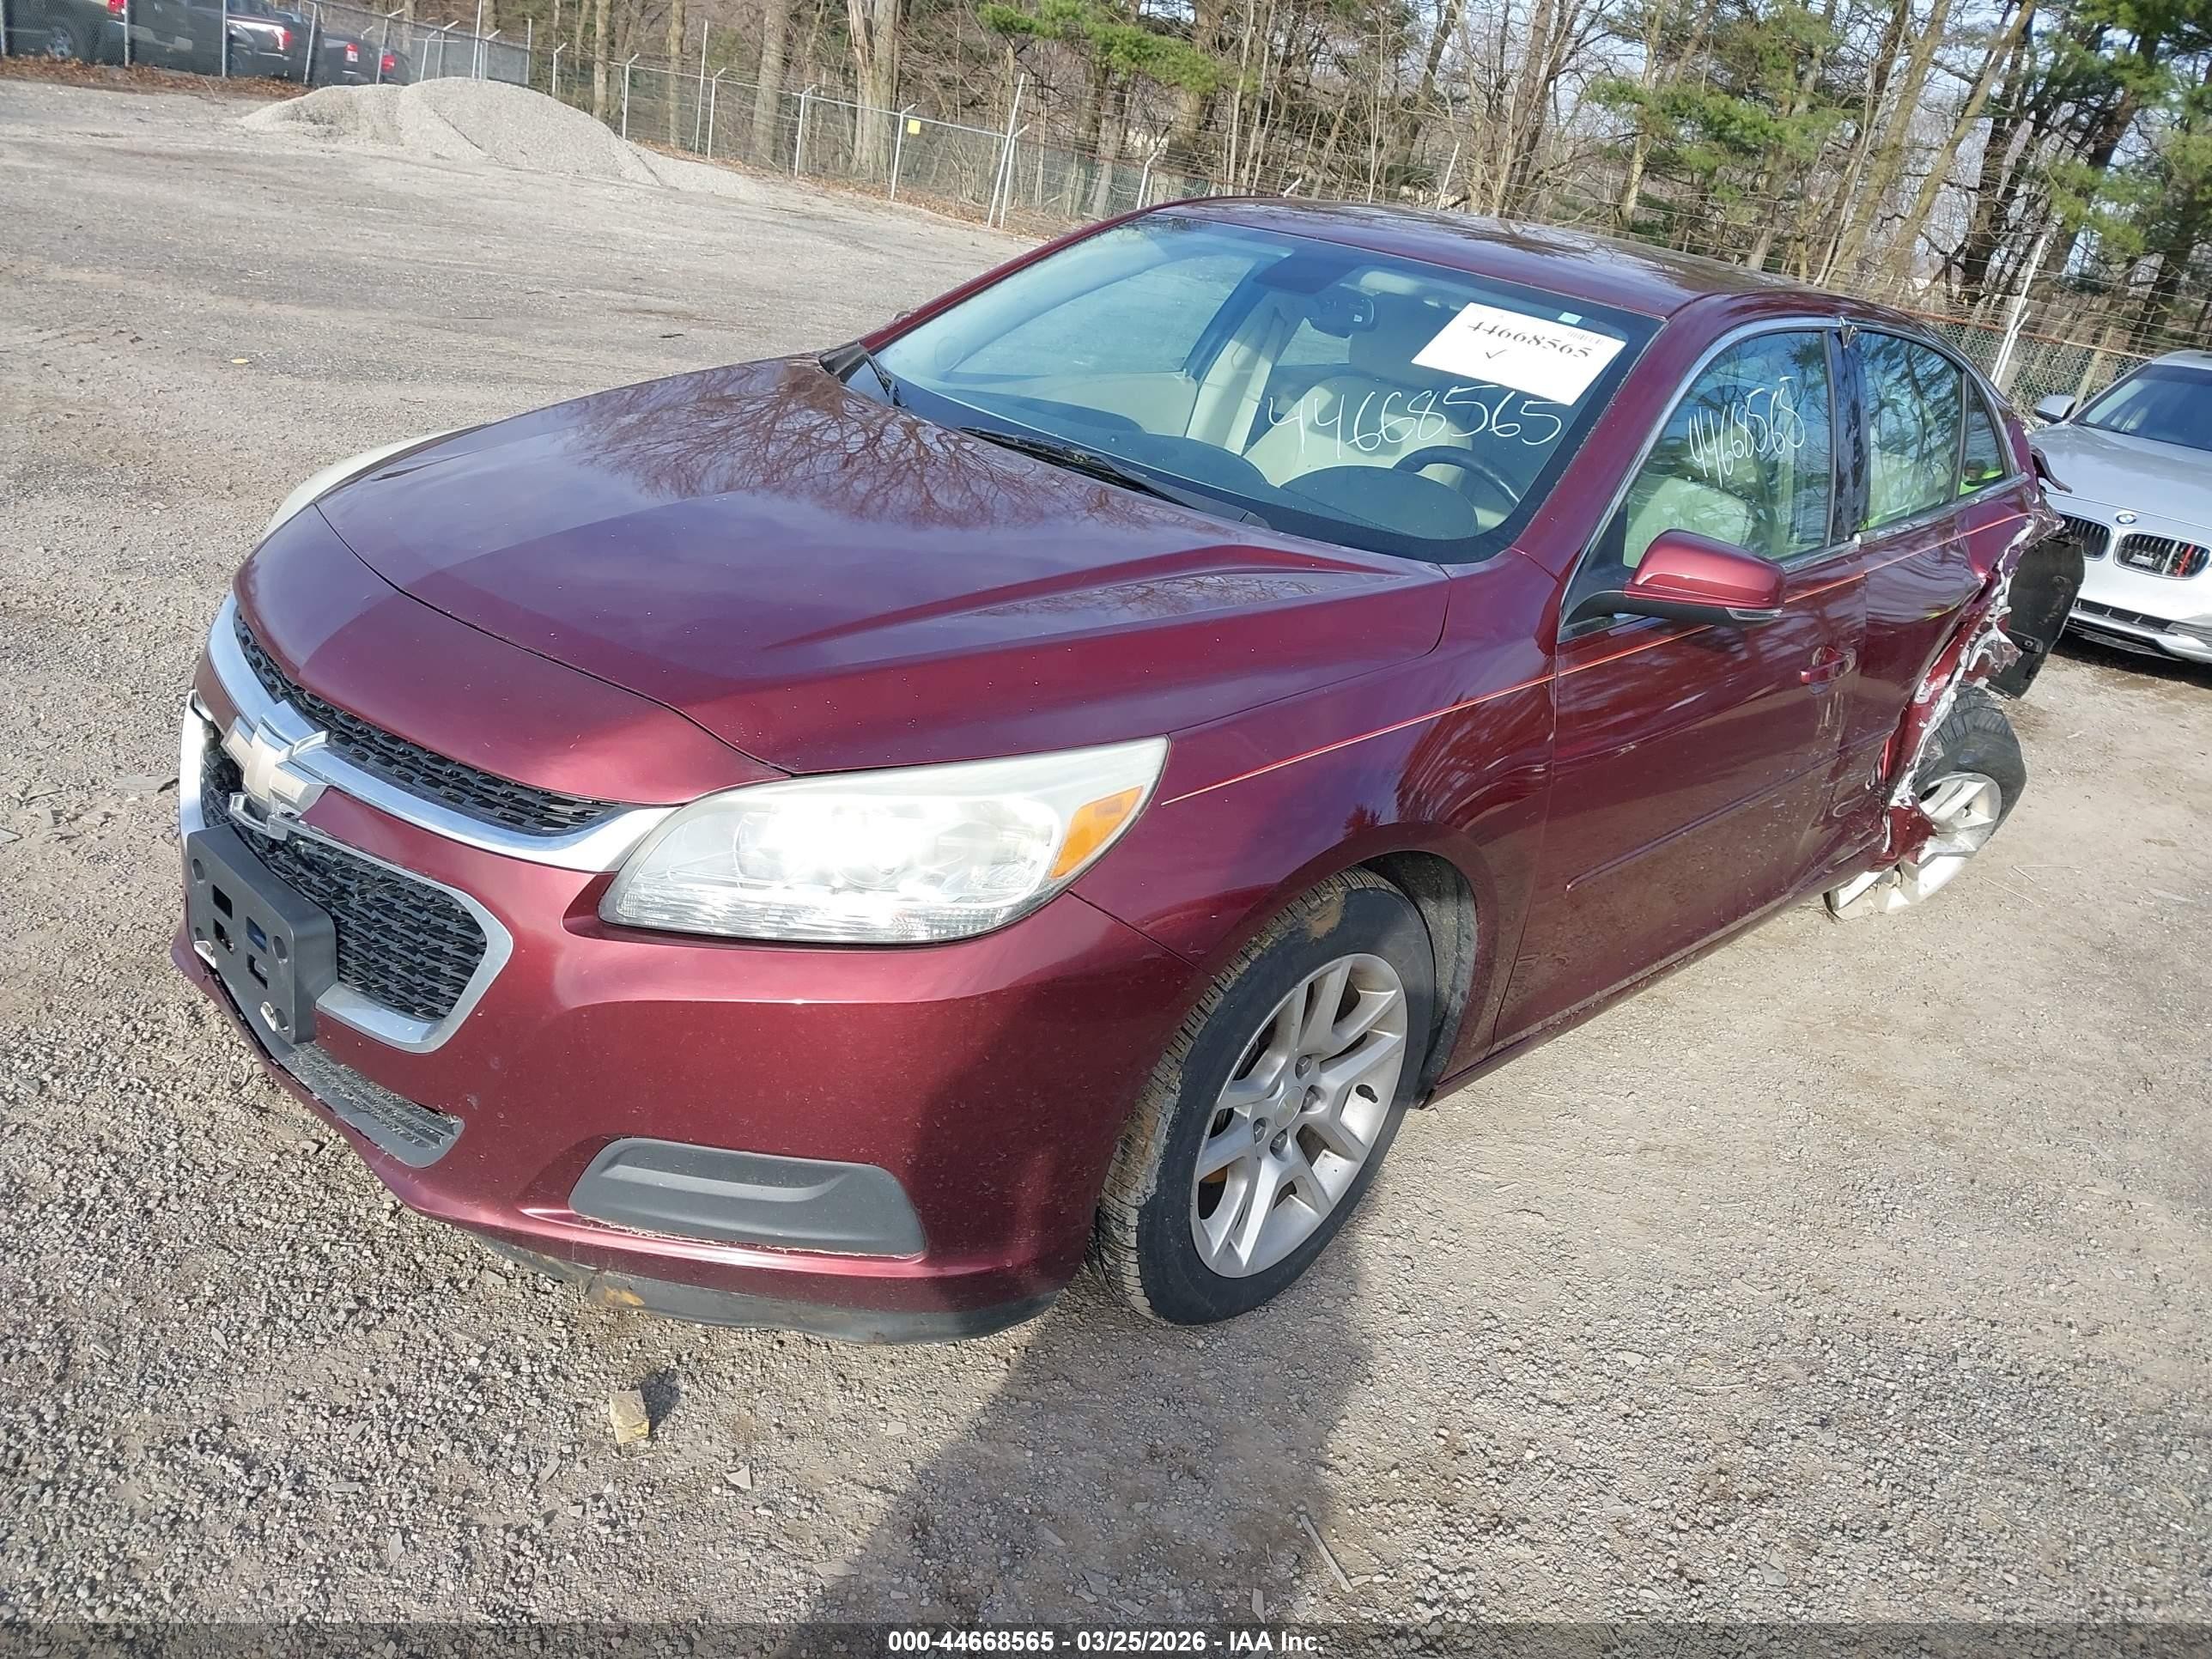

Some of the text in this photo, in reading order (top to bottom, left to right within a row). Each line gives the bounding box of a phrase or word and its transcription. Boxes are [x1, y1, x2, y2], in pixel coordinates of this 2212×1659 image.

[1468, 321, 1593, 358] 44668565
[1268, 384, 1563, 460] 44668565
[1689, 376, 1806, 489] 44668565
